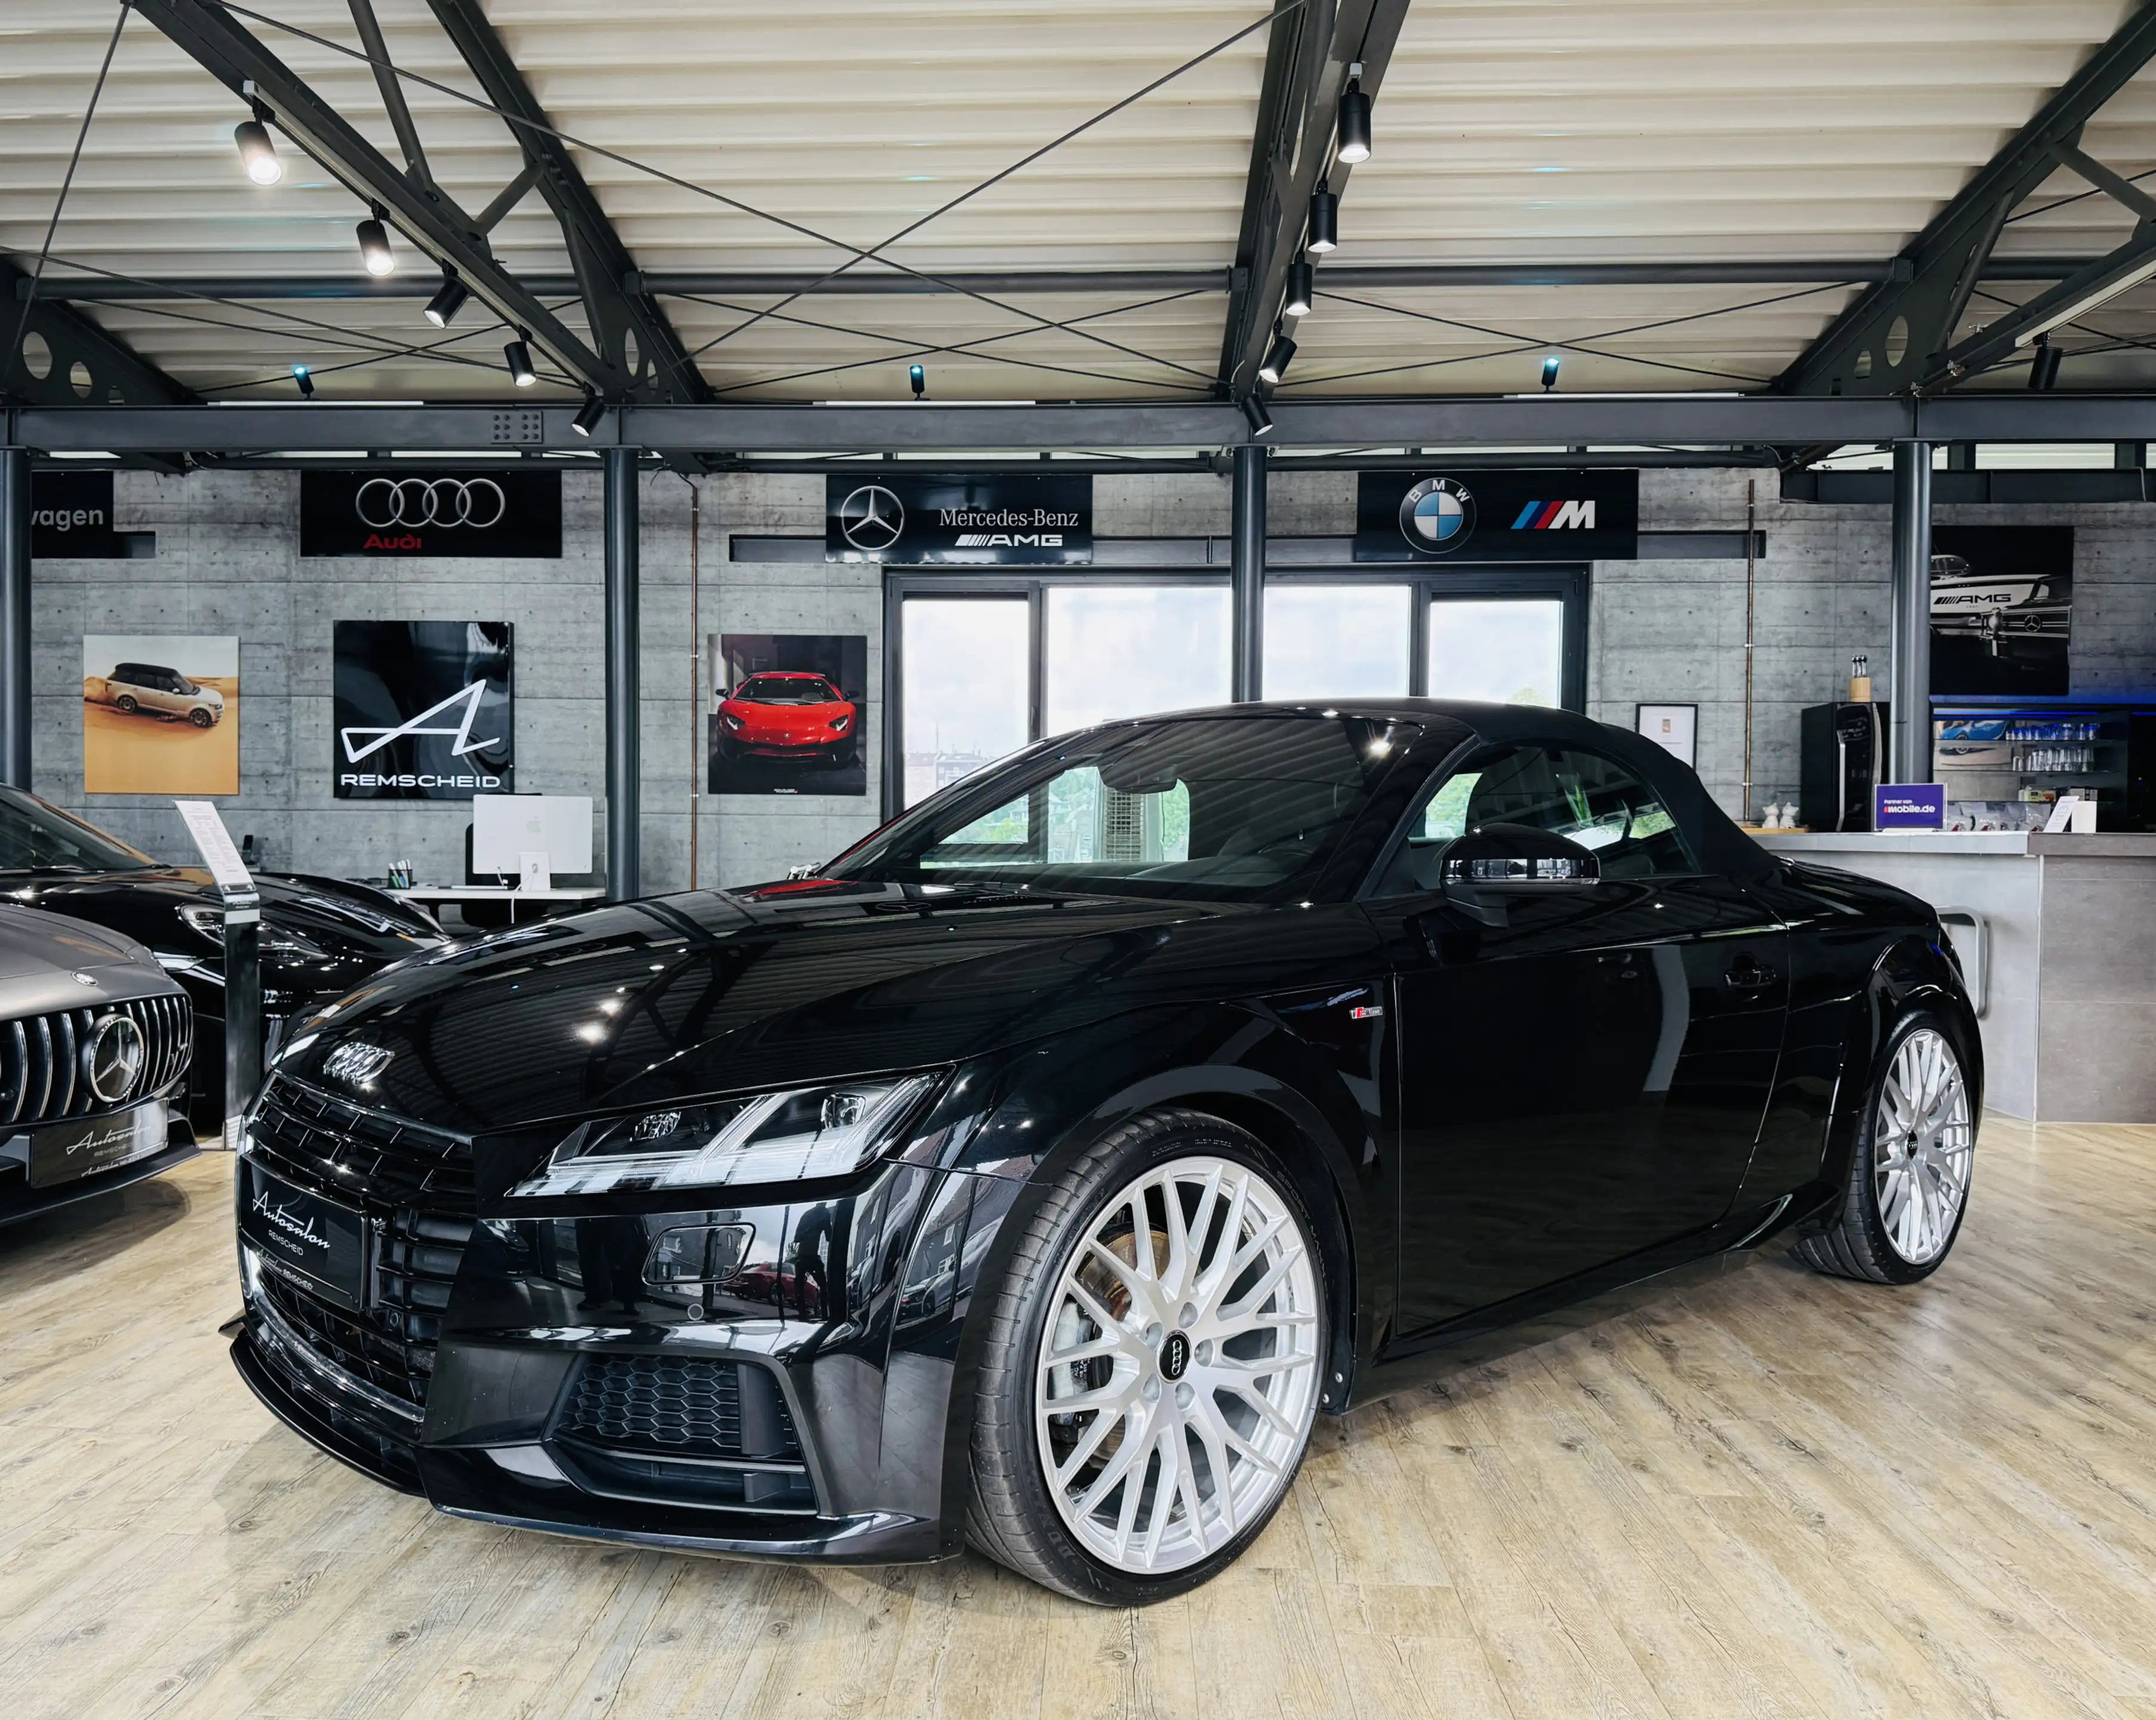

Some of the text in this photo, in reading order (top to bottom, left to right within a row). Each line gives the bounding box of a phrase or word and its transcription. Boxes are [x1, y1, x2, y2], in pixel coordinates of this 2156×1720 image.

[1408, 479, 1470, 503] BMW
[939, 509, 1079, 526] Mercedes-Benz
[363, 533, 422, 549] Audi
[340, 774, 500, 788] REMSCHEID
[1888, 804, 1936, 813] mobile.de
[1277, 1171, 1310, 1220] SPORT
[253, 1191, 330, 1249] Autosalon
[268, 1229, 304, 1256] REMSCHEID
